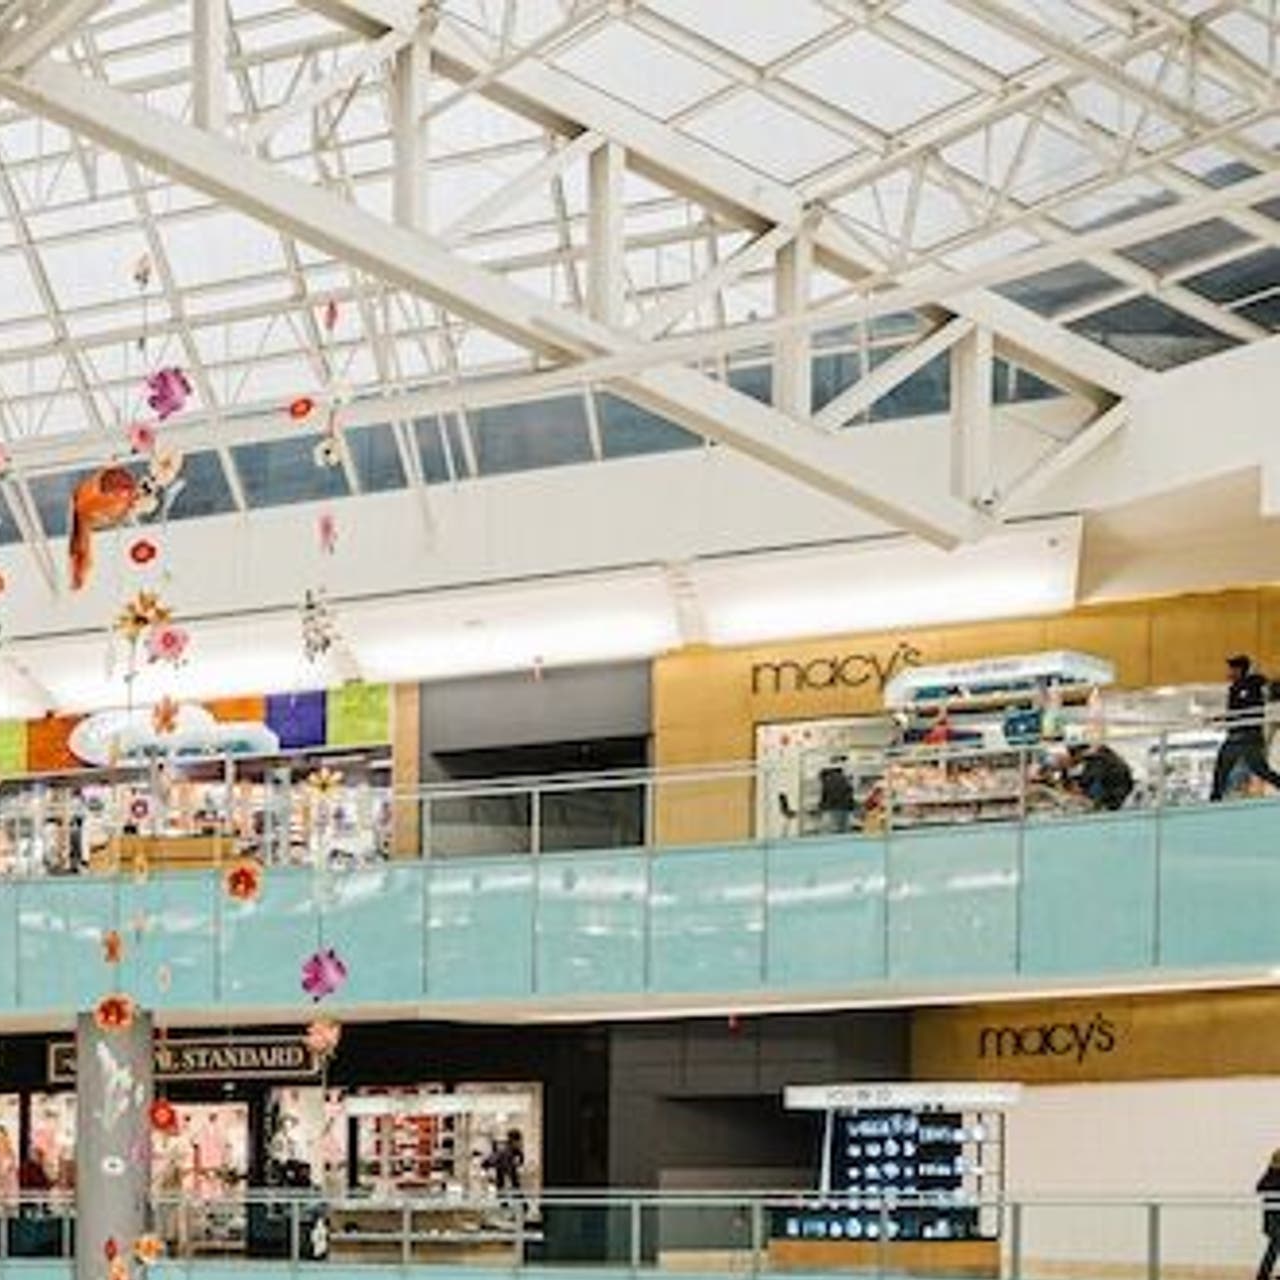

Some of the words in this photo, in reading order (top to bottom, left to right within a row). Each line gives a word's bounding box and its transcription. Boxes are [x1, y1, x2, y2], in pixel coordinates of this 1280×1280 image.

[752, 642, 922, 694] macy's
[181, 1046, 304, 1073] STANDARD
[979, 1011, 1115, 1065] macy's
